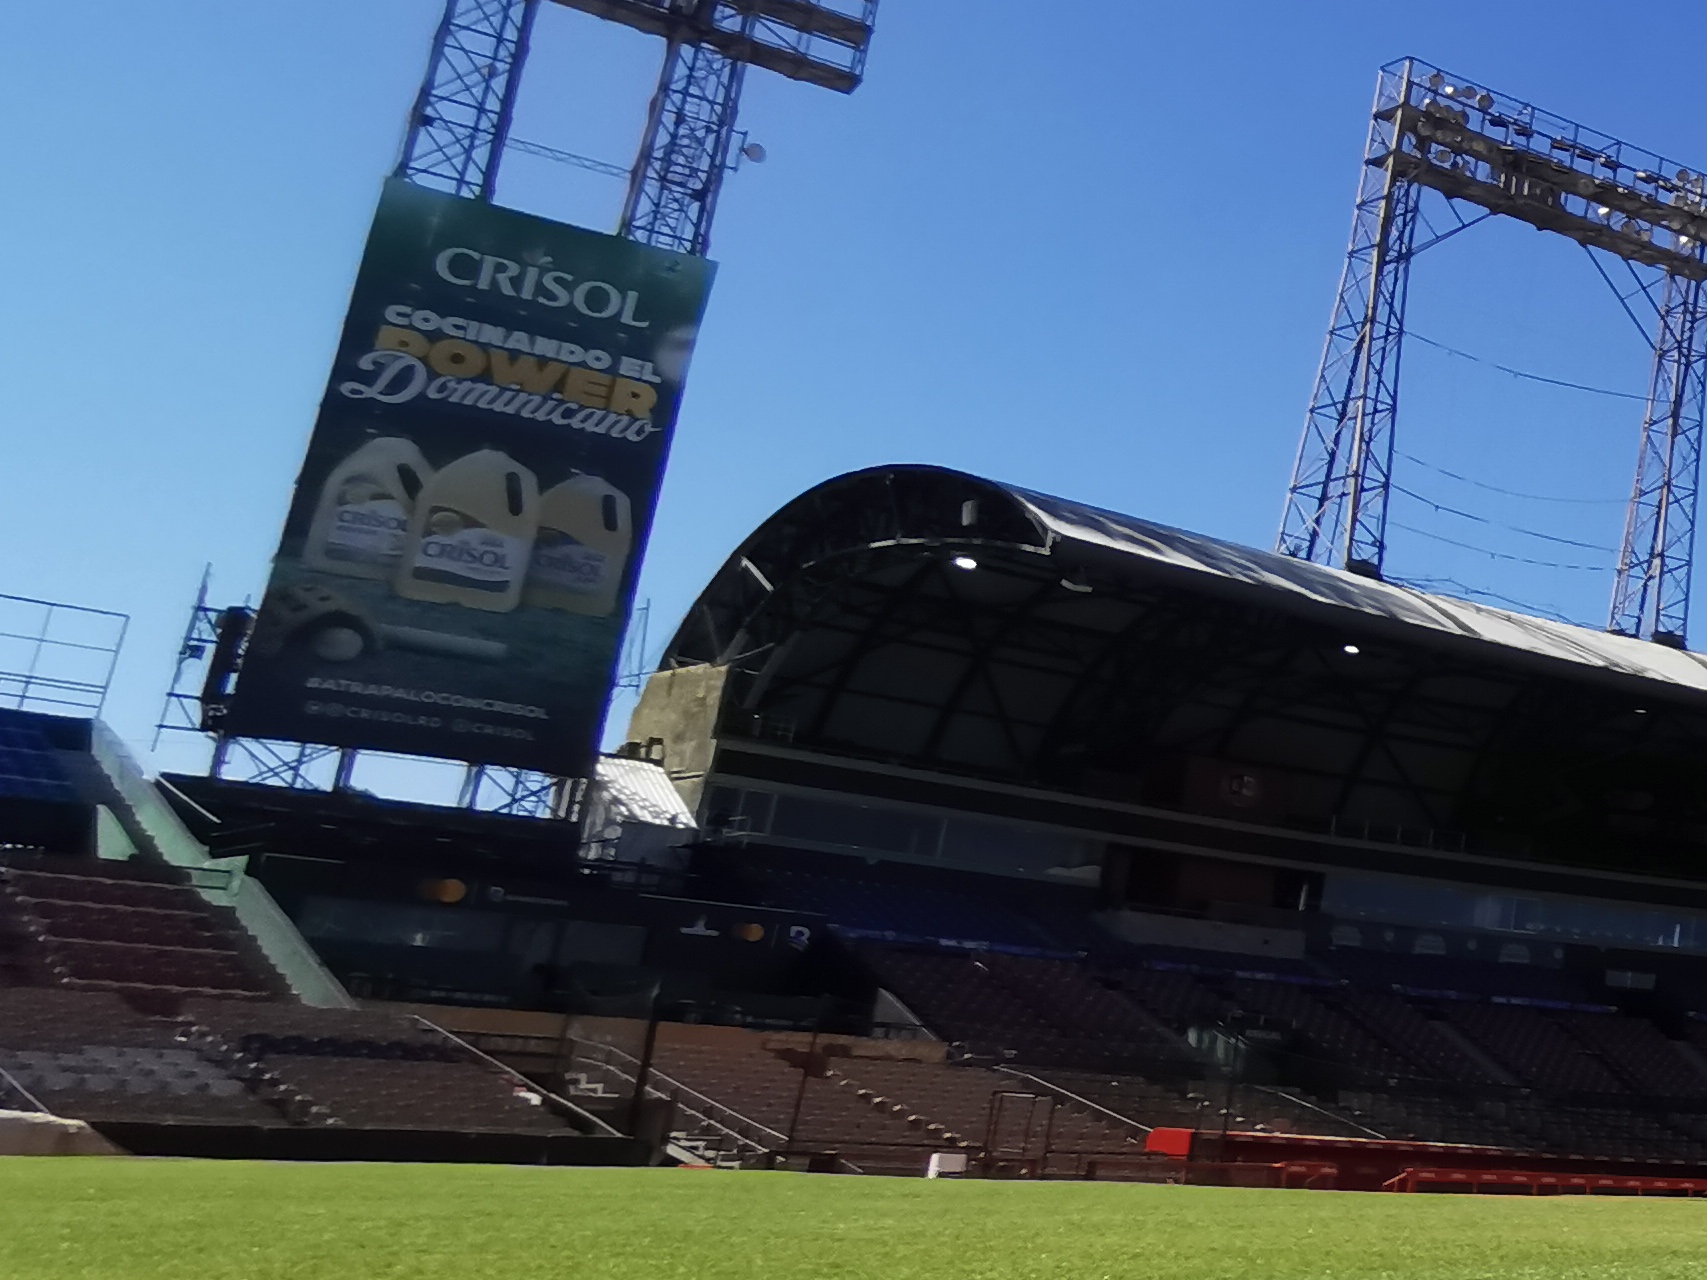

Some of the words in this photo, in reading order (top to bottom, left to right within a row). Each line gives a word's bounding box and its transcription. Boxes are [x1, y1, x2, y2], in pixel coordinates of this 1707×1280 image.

[374, 324, 659, 419] POWER
[384, 304, 613, 370] COCINANDO
[618, 355, 663, 384] EL
[339, 350, 663, 442] Dominicano
